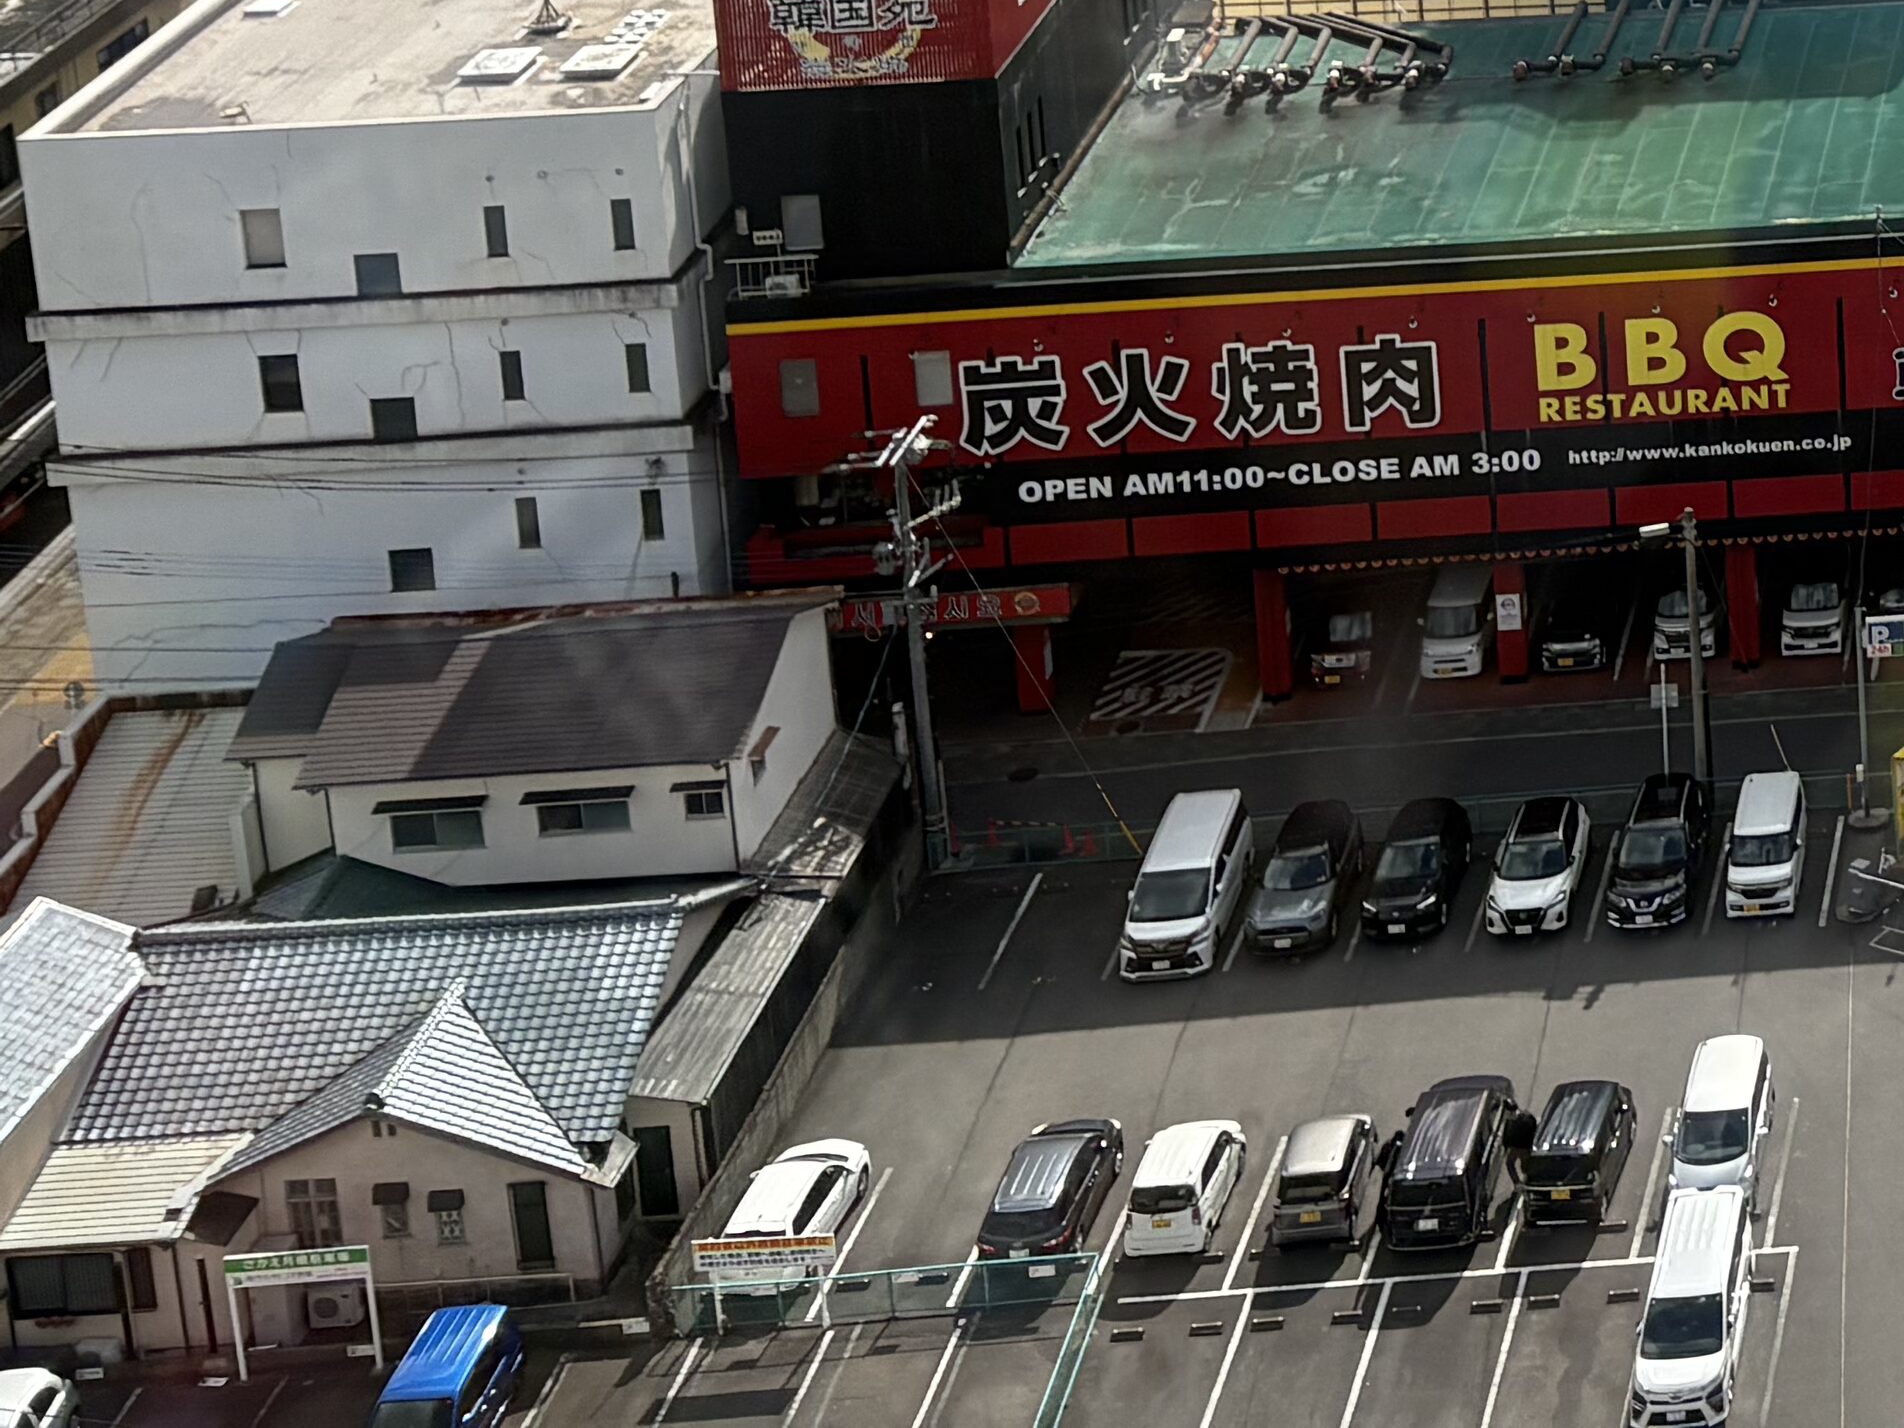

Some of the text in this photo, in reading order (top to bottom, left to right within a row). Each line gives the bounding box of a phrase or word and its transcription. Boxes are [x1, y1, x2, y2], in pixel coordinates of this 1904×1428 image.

[1534, 309, 1790, 395] BBQ
[958, 334, 1442, 456] 炭火焼肉
[1538, 382, 1791, 423] RESTAURANT
[1017, 474, 1114, 504] OPEN
[1409, 453, 1460, 480] AM
[1471, 448, 1542, 477] 3:00
[1567, 432, 1853, 467] http://www.kankokuen.co.jp
